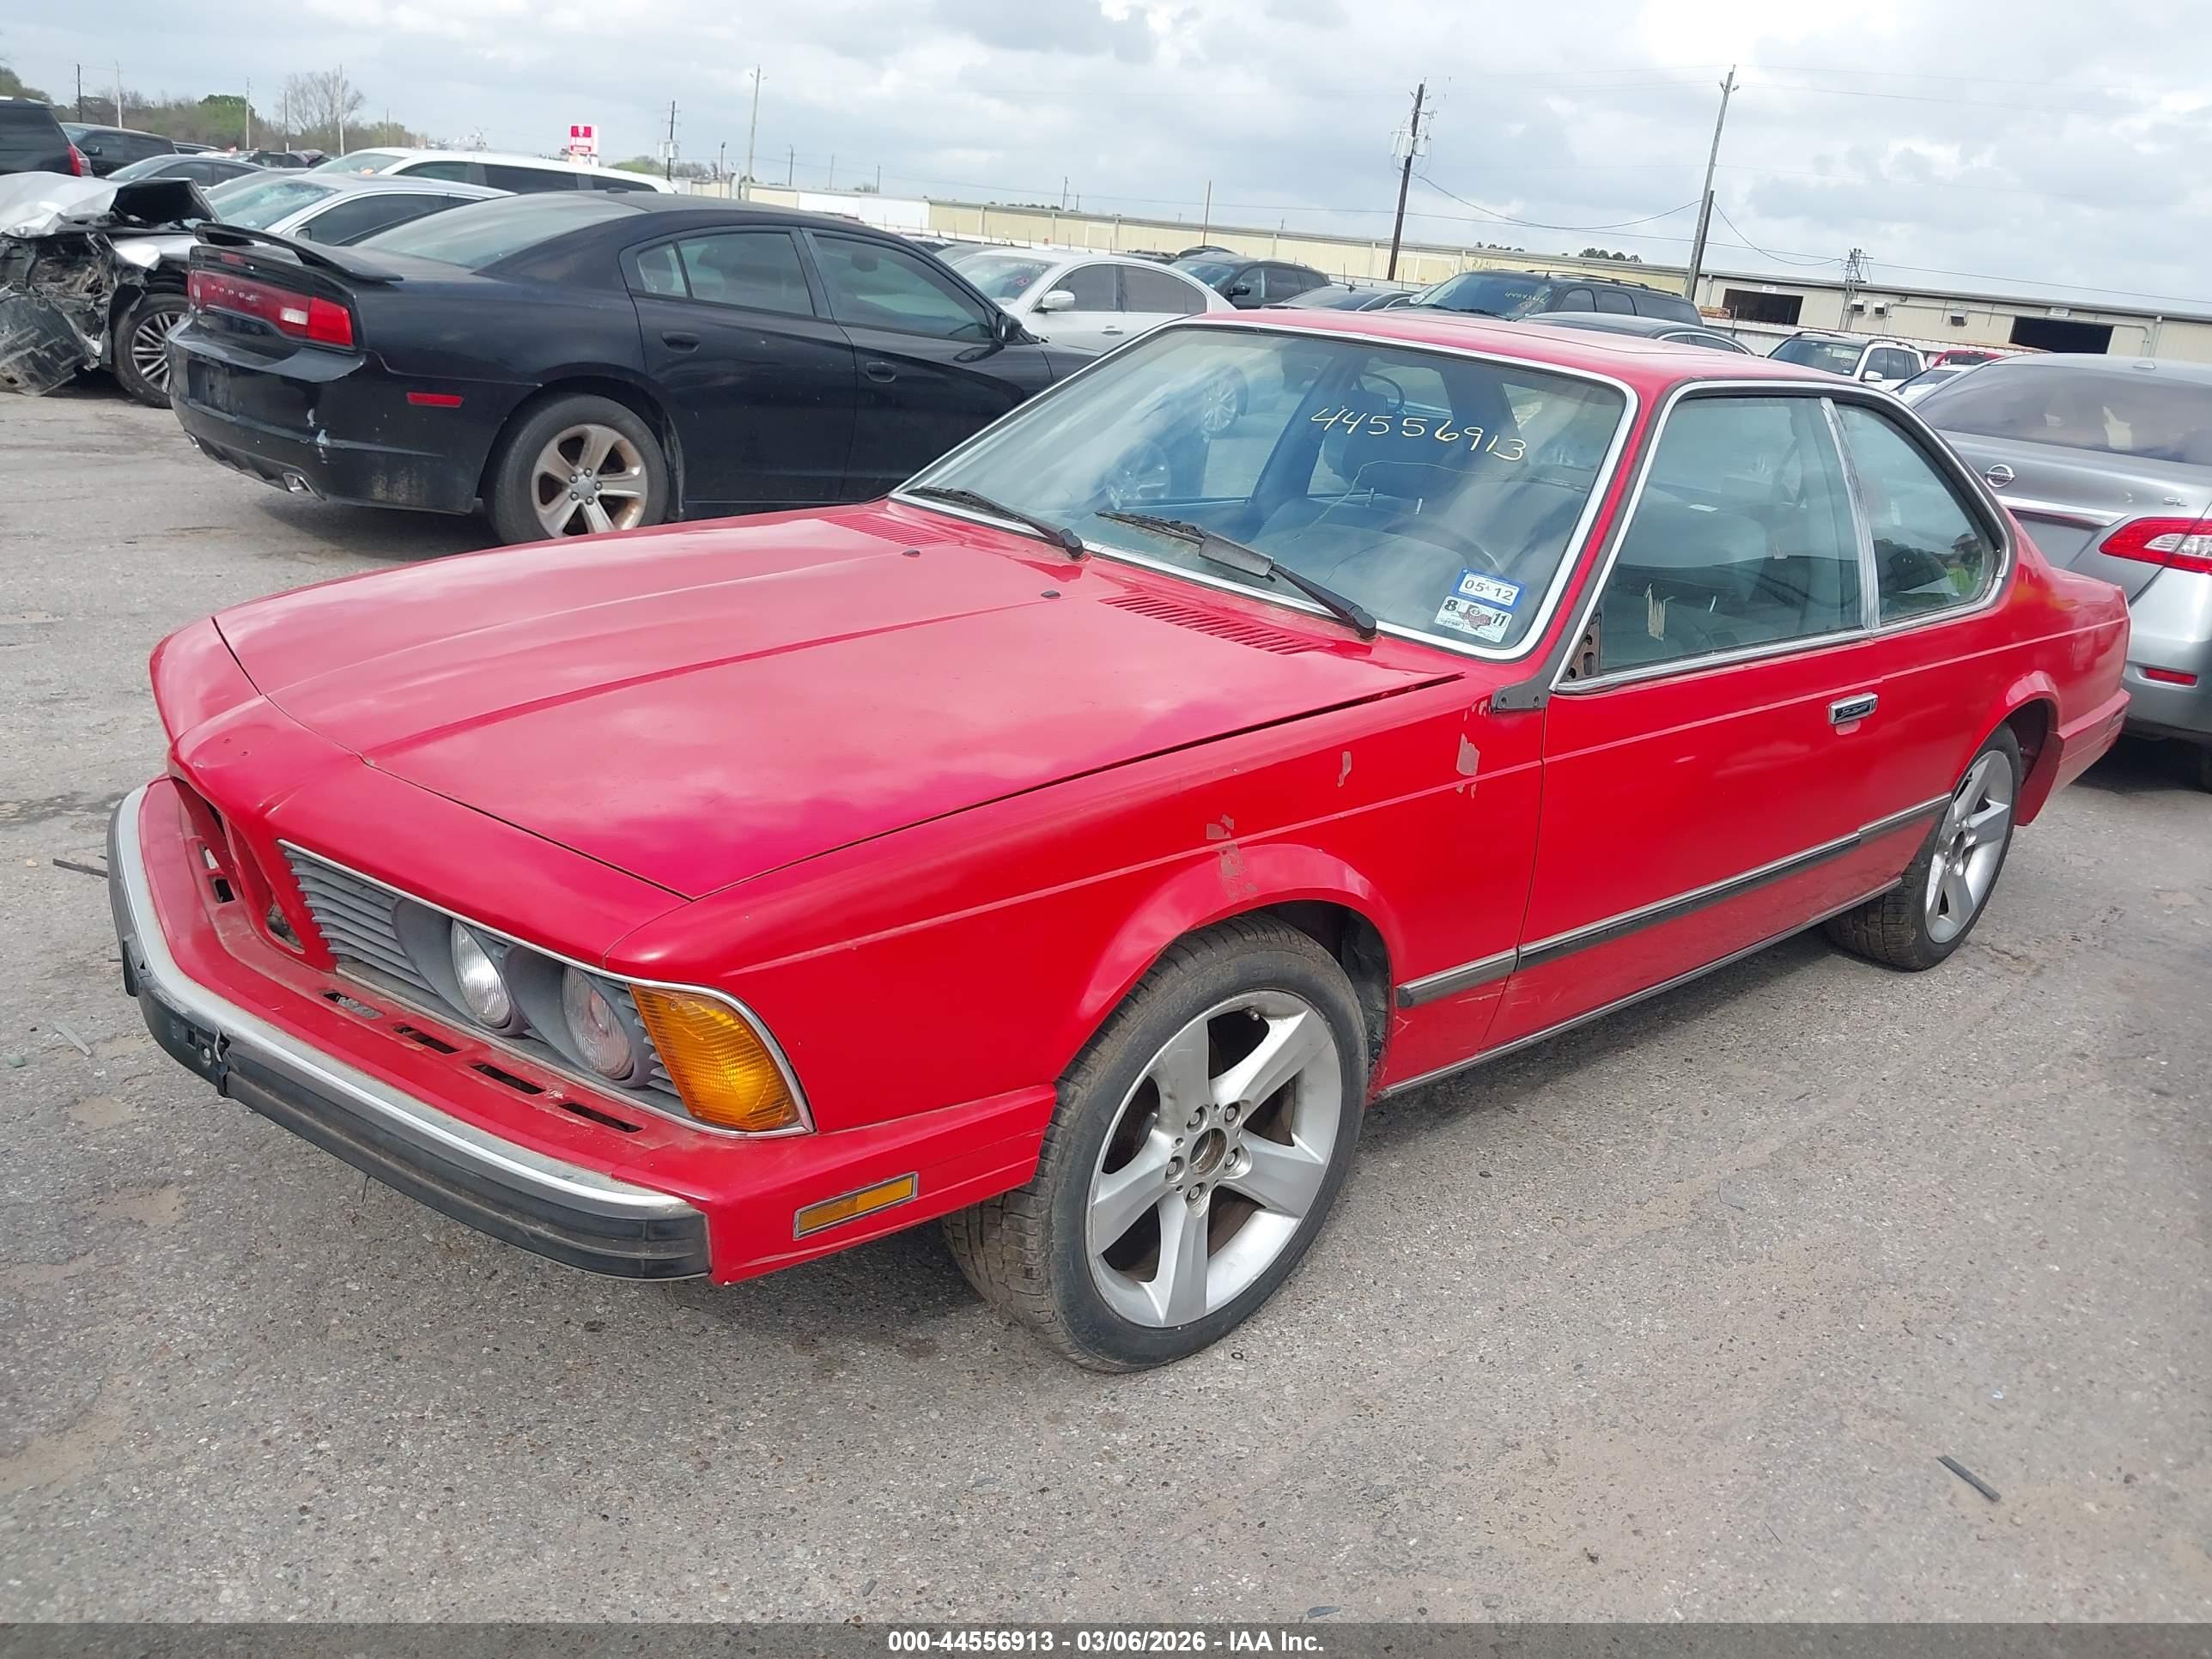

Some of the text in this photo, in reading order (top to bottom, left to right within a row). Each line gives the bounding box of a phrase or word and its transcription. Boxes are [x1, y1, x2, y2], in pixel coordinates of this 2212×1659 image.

[1310, 407, 1527, 461] 44556913
[1464, 580, 1486, 592] 05
[1494, 587, 1514, 601] 12
[1443, 599, 1507, 627] 8 11
